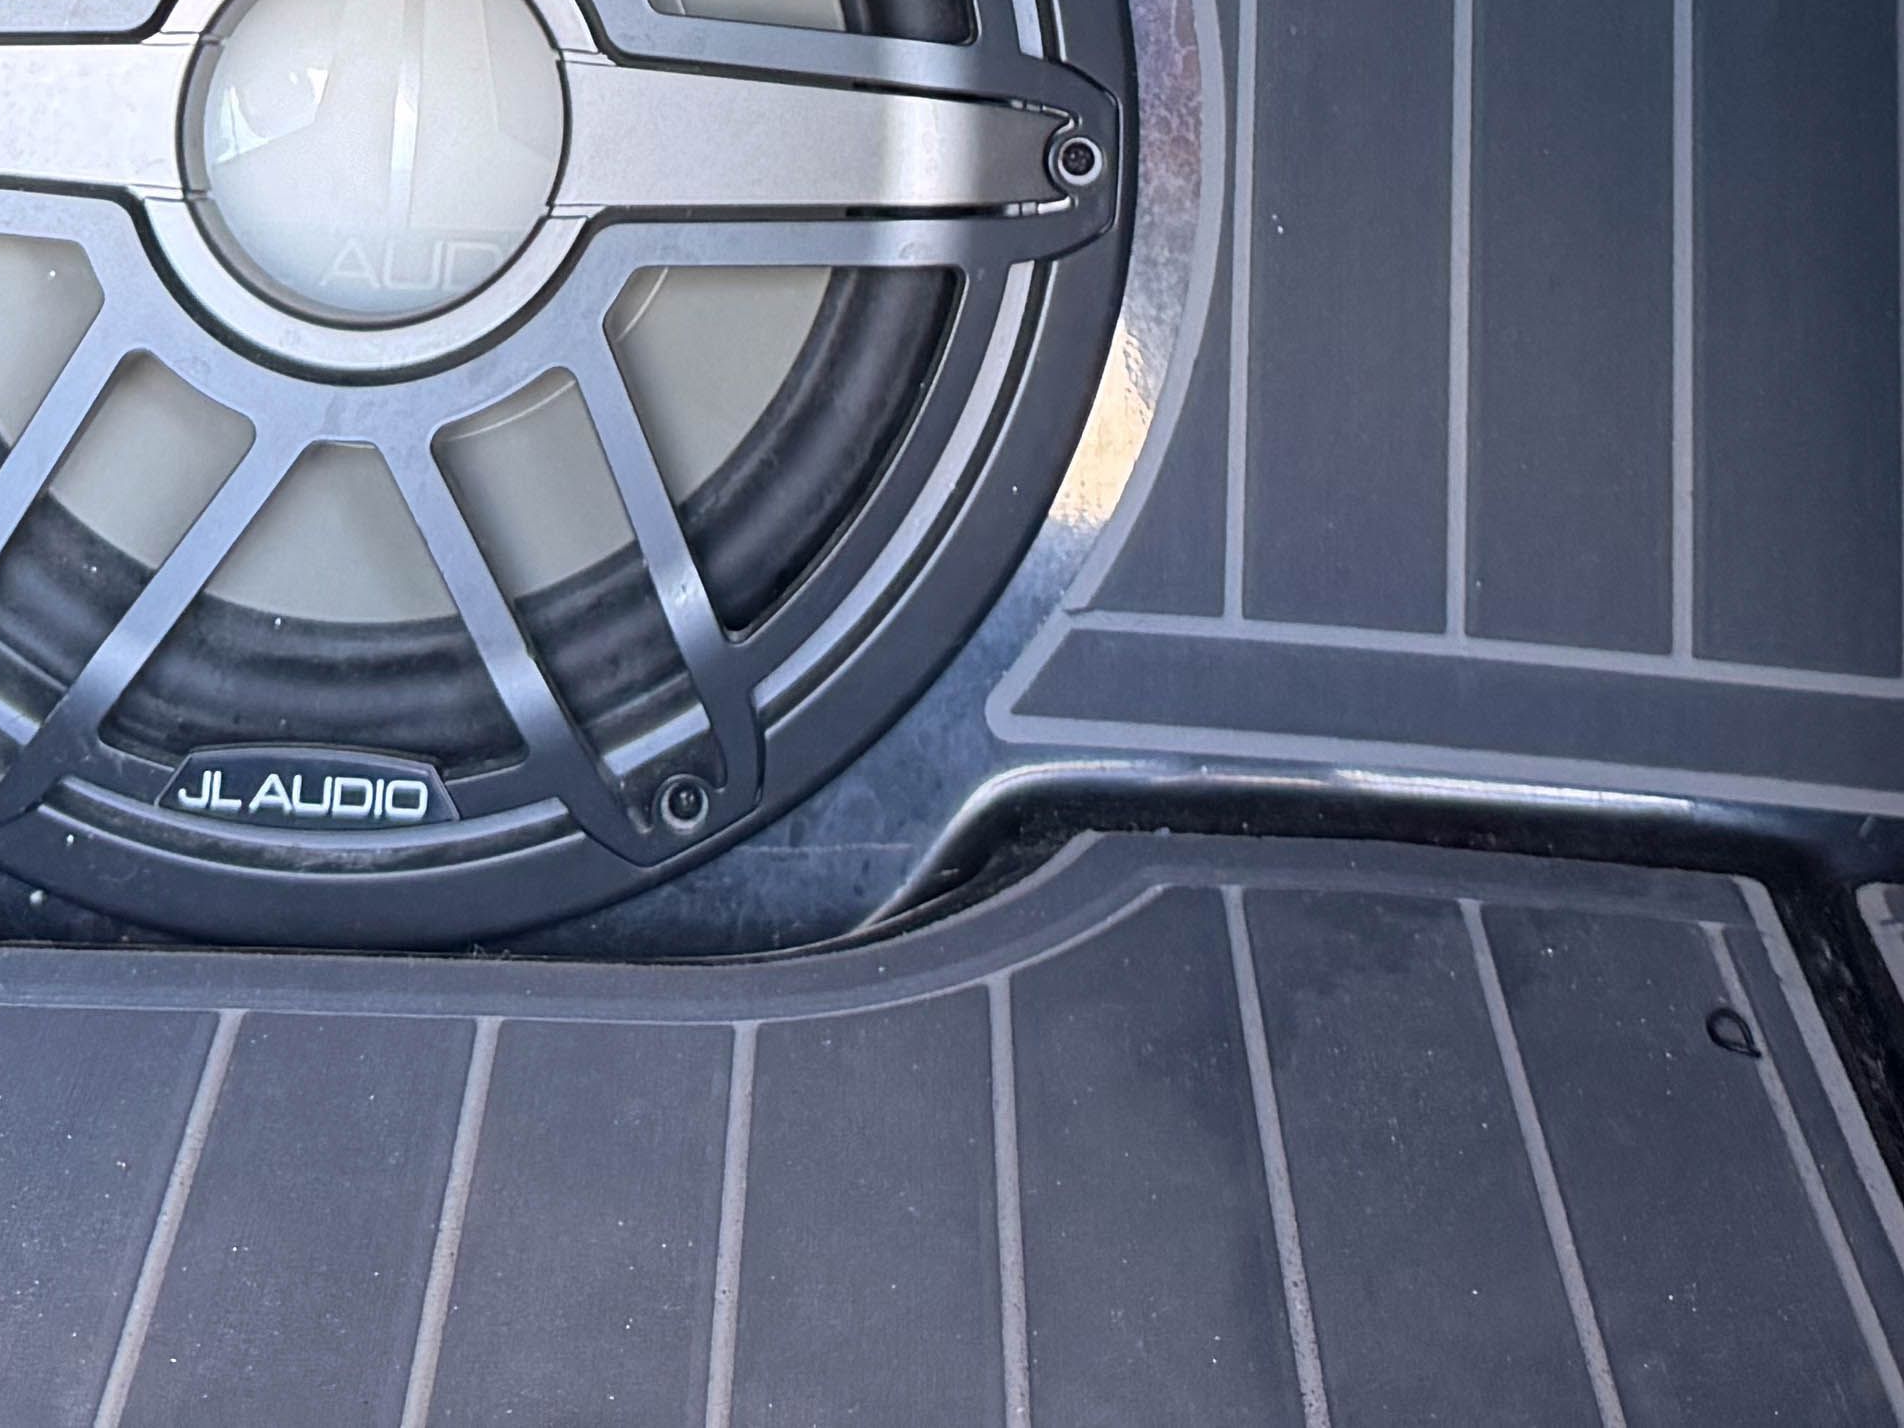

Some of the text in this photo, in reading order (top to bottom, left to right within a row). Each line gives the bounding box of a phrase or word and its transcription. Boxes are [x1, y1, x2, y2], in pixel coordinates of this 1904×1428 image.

[318, 236, 506, 292] AUD
[177, 769, 429, 822] JL AUDIO
